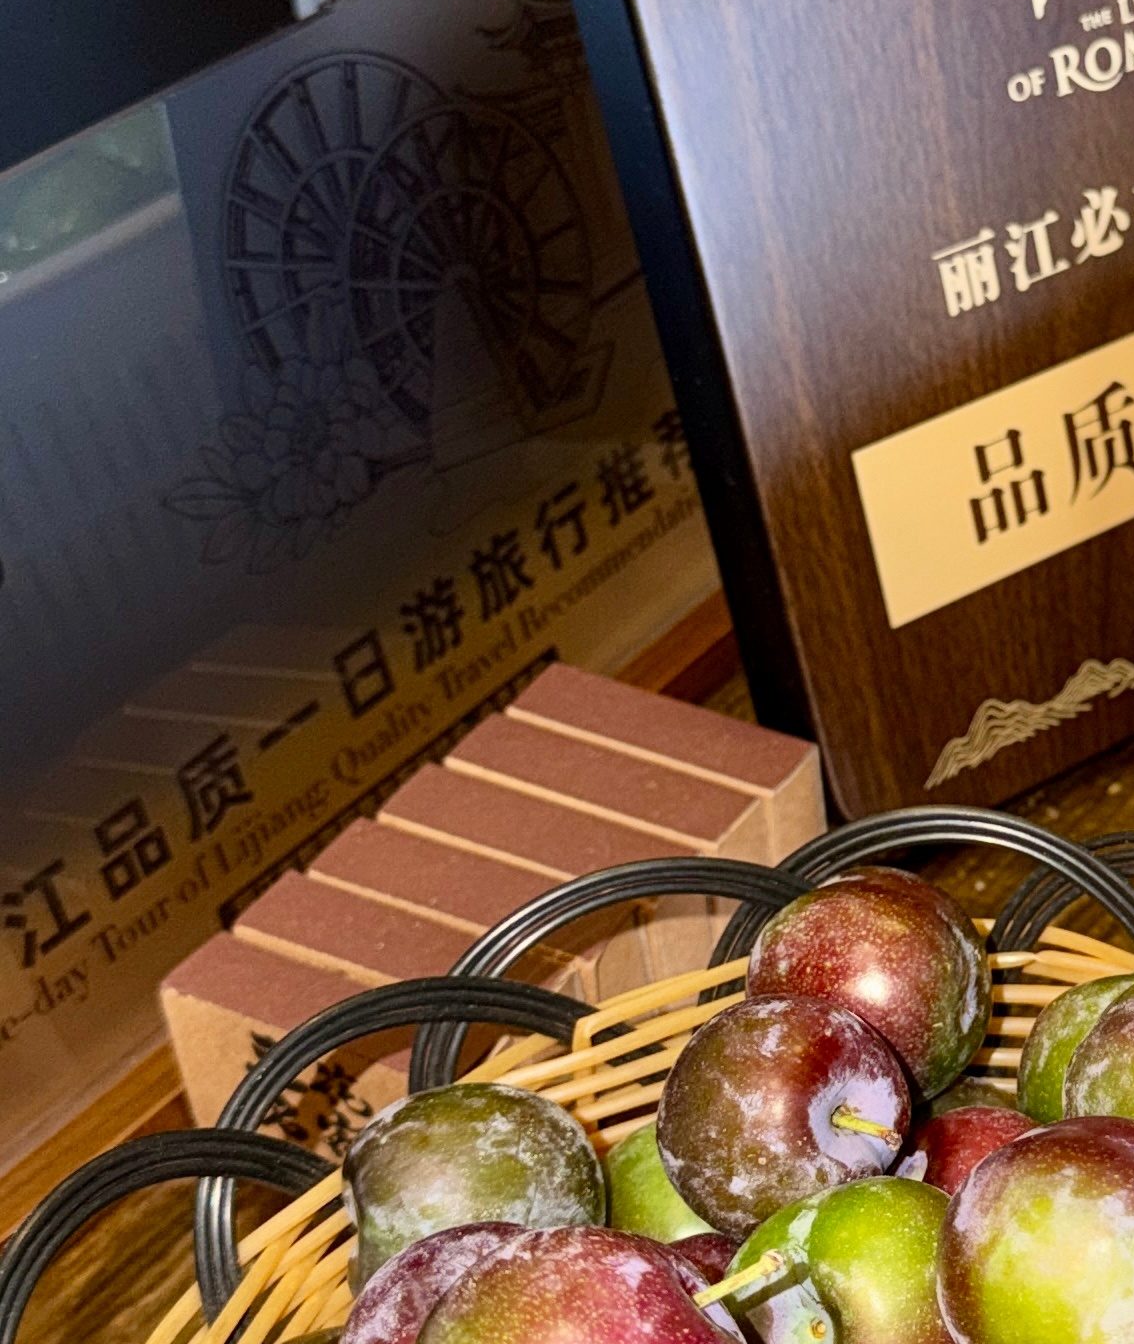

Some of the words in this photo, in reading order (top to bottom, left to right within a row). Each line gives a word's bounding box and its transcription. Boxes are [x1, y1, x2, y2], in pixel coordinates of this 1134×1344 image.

[1078, 7, 1114, 33] THE
[1006, 67, 1047, 103] OF
[89, 896, 172, 963] Tour
[178, 855, 211, 906] of
[331, 691, 433, 787] Quality
[434, 626, 518, 700] Travel
